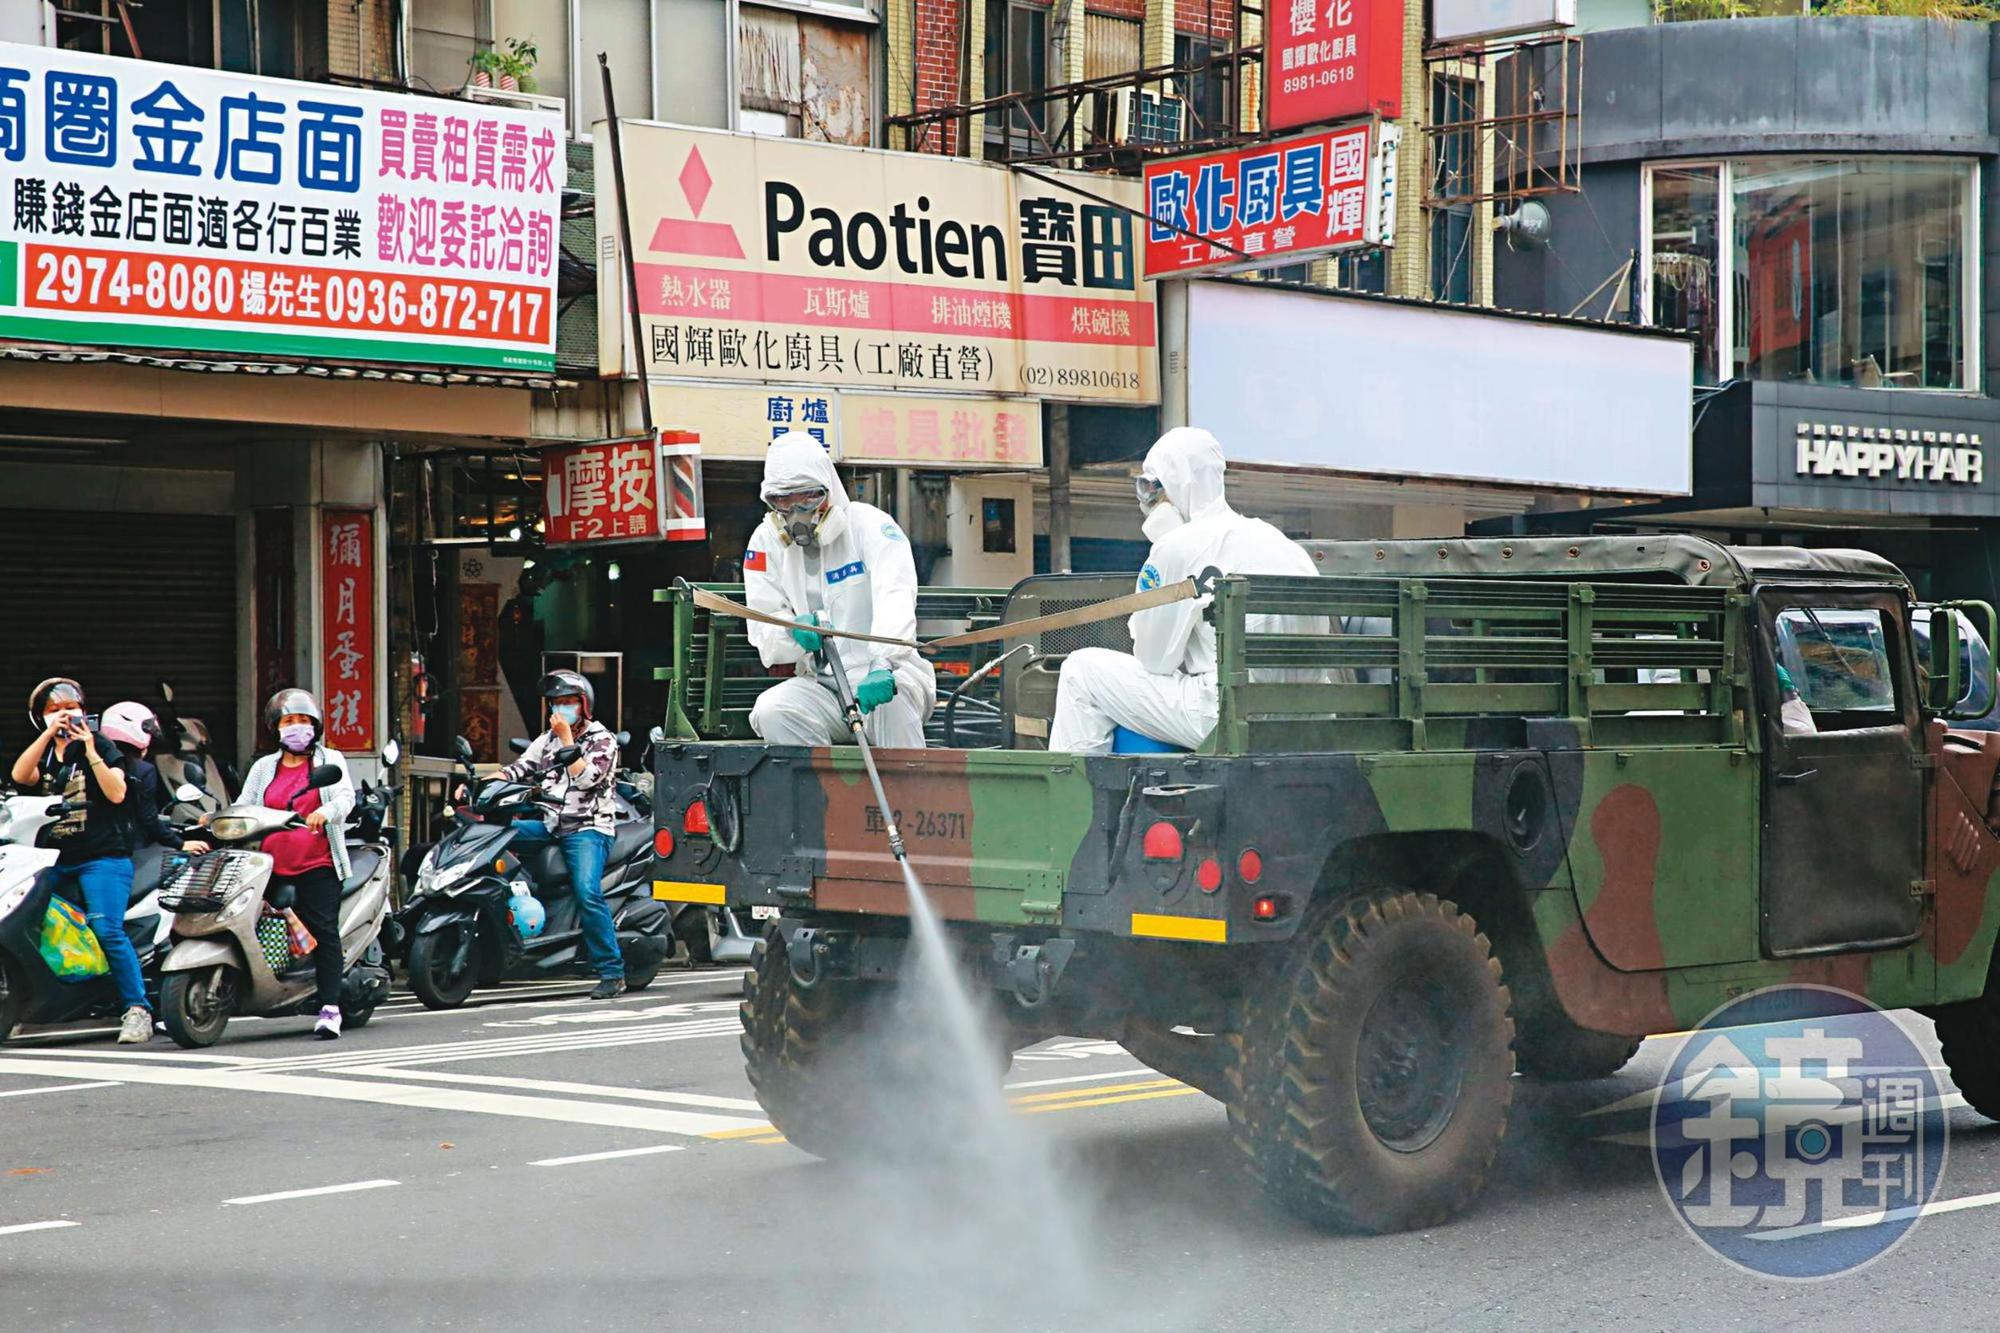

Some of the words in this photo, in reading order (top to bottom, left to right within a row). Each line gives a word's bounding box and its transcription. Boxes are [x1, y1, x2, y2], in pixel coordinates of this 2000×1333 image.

[1283, 65, 1355, 94] 8981-0618
[378, 109, 556, 194] 買賣租賃需求
[1325, 131, 1367, 240] 國輝
[14, 177, 362, 260] 賺錢金店面適各行百業
[377, 193, 554, 278] 歡迎委託洽詢
[765, 180, 1008, 282] Paotien
[1019, 197, 1136, 291] 寶田
[36, 252, 234, 313] 2974-8080
[241, 269, 322, 318] 楊先生
[325, 276, 543, 337] 0936-872-717
[661, 274, 733, 310] 熱水器
[803, 287, 871, 319] 瓦斯爐
[931, 295, 1013, 331] 排油煙機
[1071, 306, 1131, 338] 烘碗機
[1019, 365, 1140, 390] (02)89810618
[329, 522, 365, 736] 彌月蛋糕
